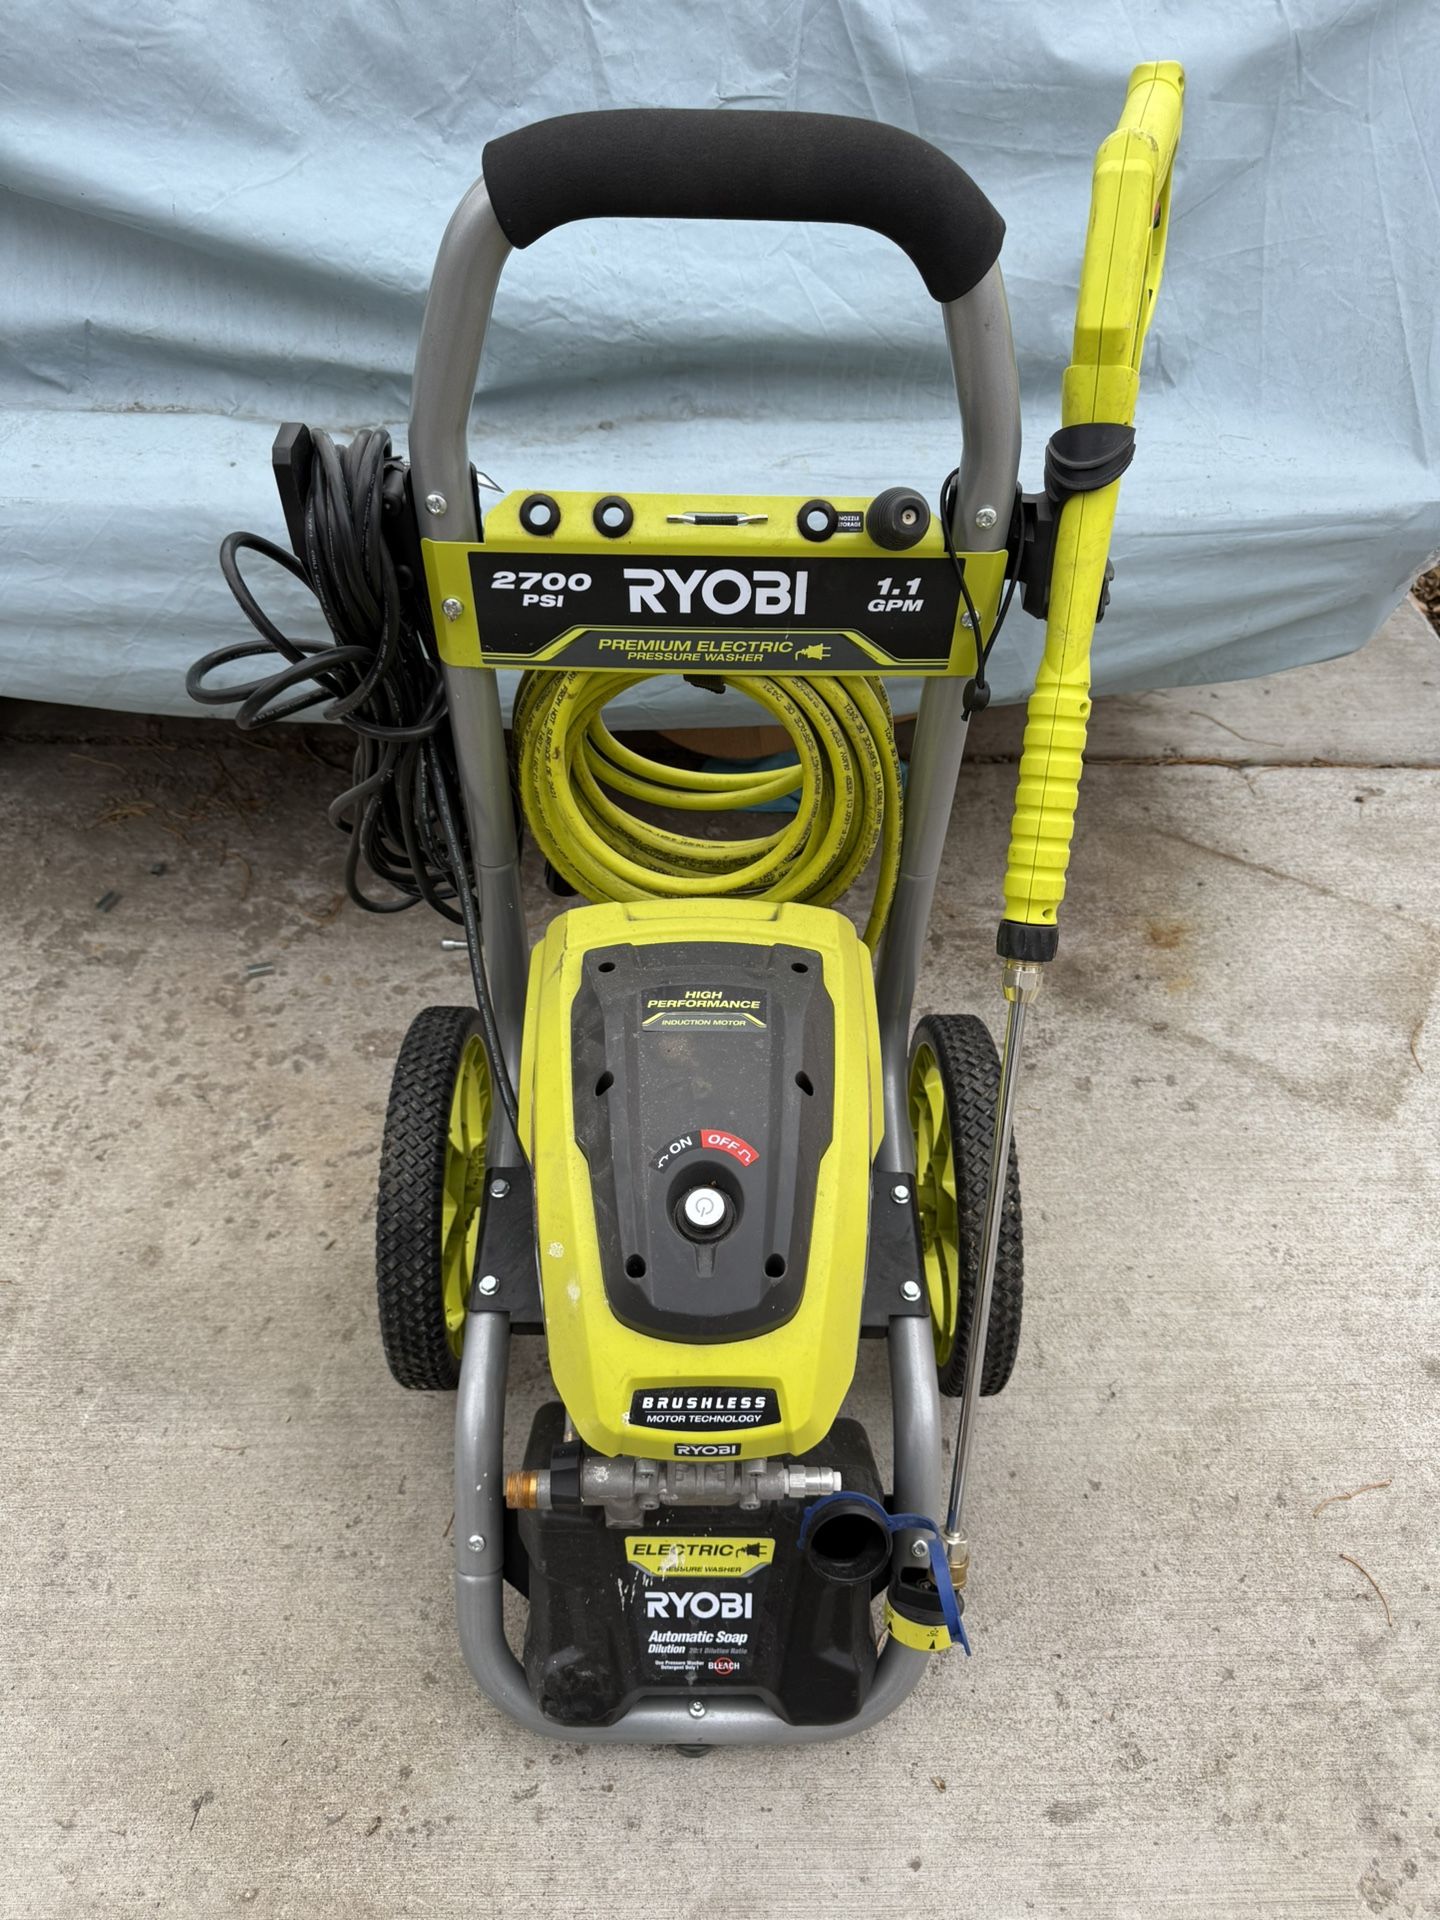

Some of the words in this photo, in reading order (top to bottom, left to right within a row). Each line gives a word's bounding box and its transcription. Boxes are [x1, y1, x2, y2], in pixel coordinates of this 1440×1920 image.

[491, 571, 592, 591] 2700
[877, 577, 922, 596] 1.1
[624, 568, 808, 616] RYOBI
[522, 594, 564, 608] PSI
[868, 599, 924, 612] GPM
[598, 638, 692, 652] PREMIUM
[696, 640, 794, 653] ELECTRIC
[628, 652, 700, 662] PRESSURE
[704, 653, 764, 662] WASHER
[762, 682, 784, 702] 2421
[842, 702, 859, 722] 2421
[685, 991, 722, 999] HIGH
[647, 1000, 760, 1009] PERFORMANCE
[670, 1136, 692, 1154] ON
[708, 1134, 740, 1149] OFF
[642, 1396, 766, 1409] BRUSHLESS
[646, 1415, 686, 1423] MOTOR
[676, 1445, 736, 1455] RYOBI
[633, 1544, 734, 1556] ELECTRIC
[644, 1592, 752, 1619] RYOBI
[648, 1630, 714, 1643] Automatic
[716, 1630, 748, 1646] Soap
[648, 1644, 686, 1654] Dilution
